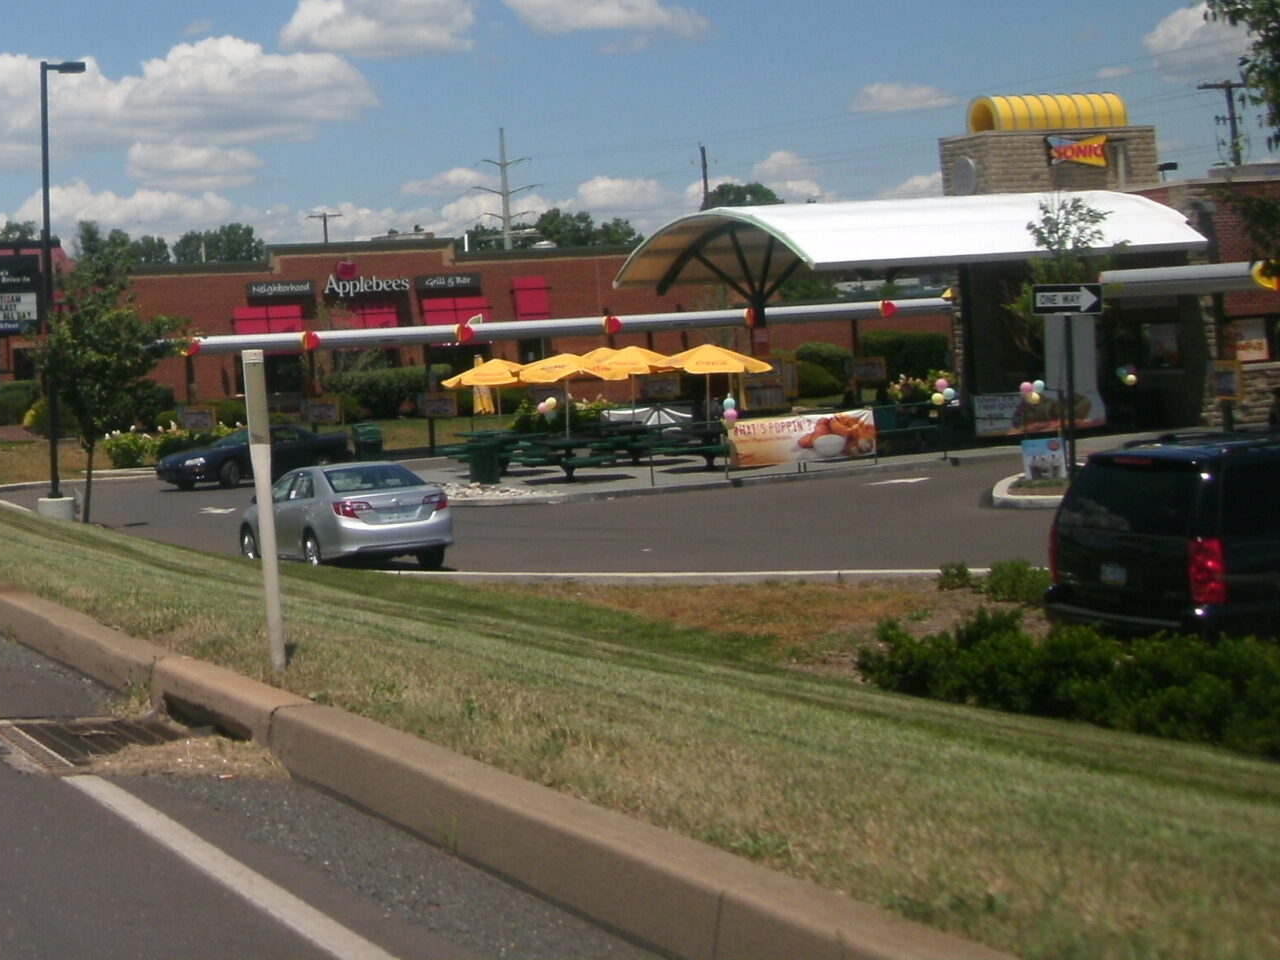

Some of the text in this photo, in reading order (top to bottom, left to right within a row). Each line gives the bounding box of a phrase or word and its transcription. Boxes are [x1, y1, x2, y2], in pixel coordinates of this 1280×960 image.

[1052, 144, 1105, 160] SONIC
[324, 274, 410, 297] Applebee's
[425, 277, 446, 287] Grill
[455, 276, 471, 286] Bar
[252, 282, 310, 295] Neighborhood
[1040, 293, 1081, 305] ONE WAY
[3, 311, 14, 320] ALL
[733, 423, 767, 437] WHAT'S
